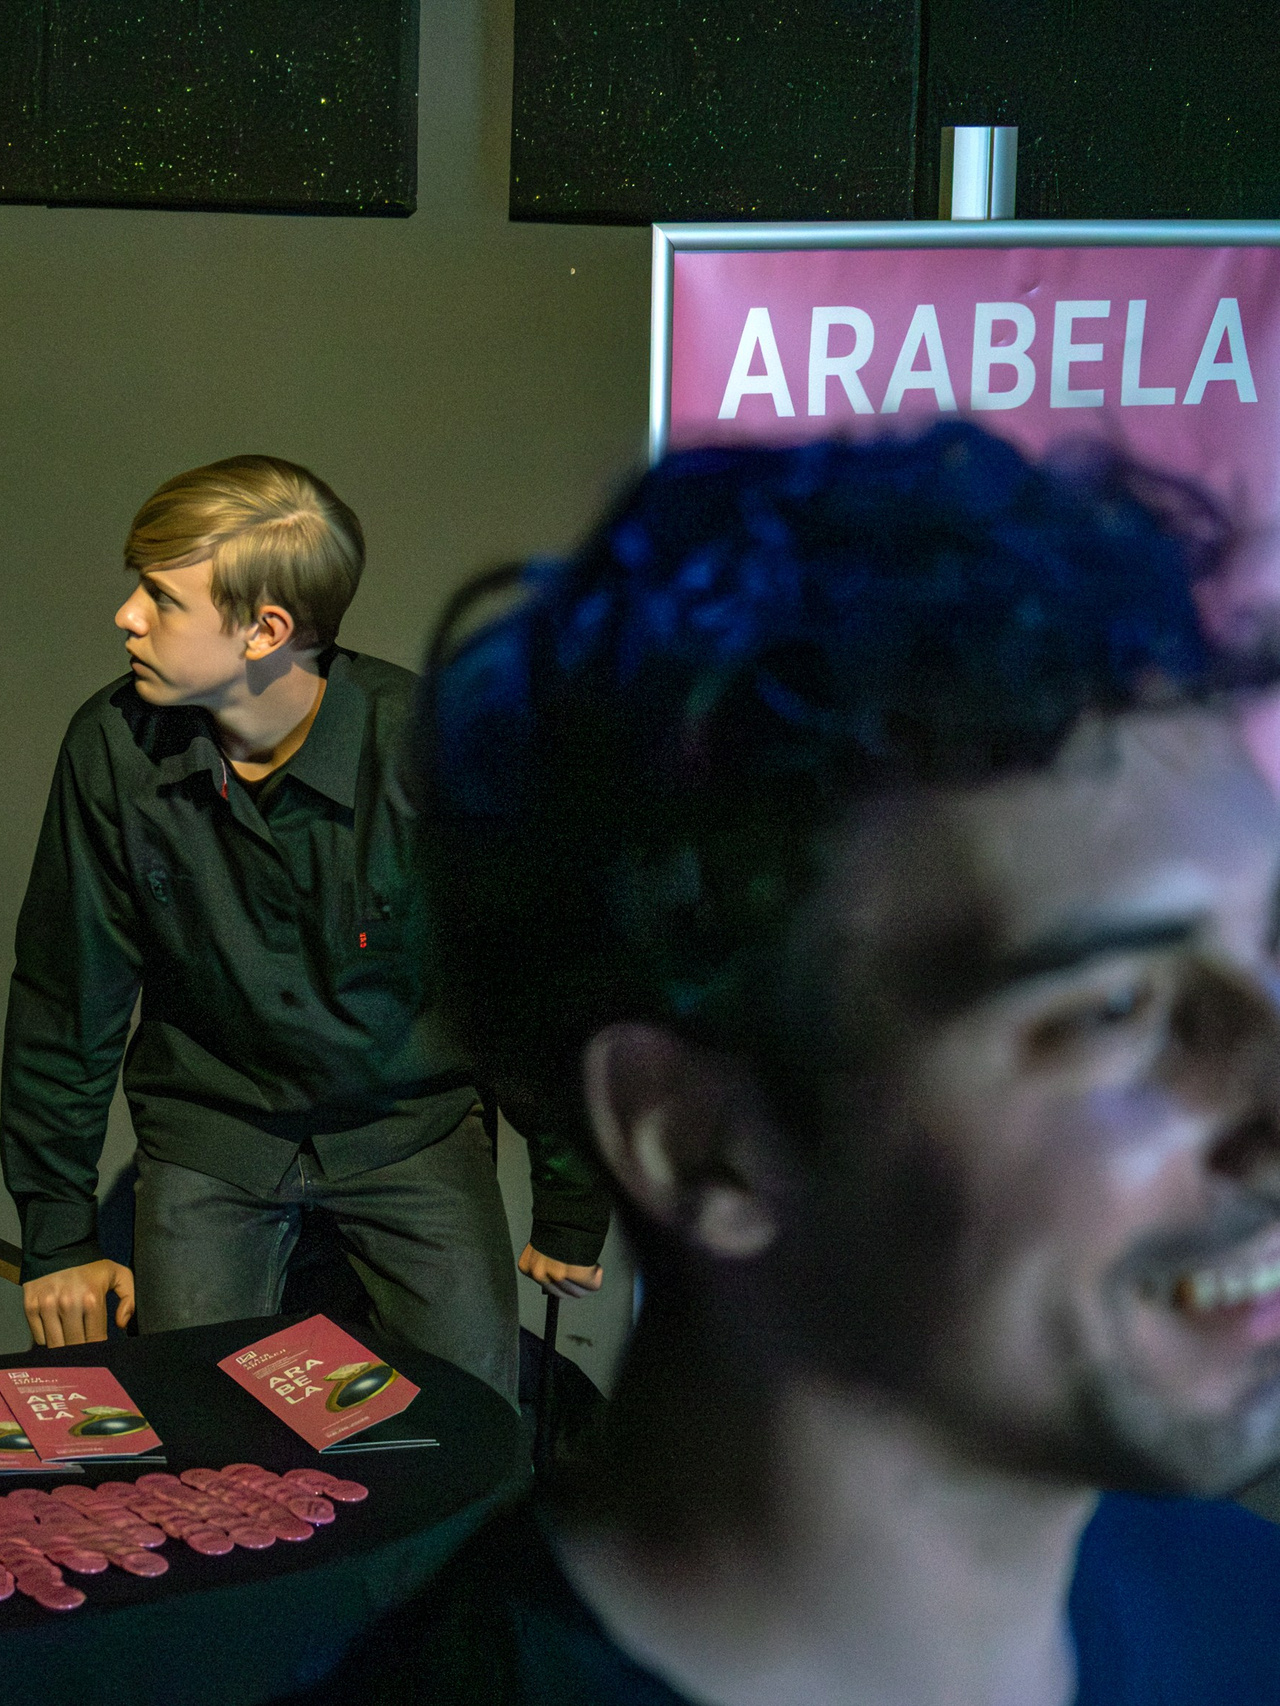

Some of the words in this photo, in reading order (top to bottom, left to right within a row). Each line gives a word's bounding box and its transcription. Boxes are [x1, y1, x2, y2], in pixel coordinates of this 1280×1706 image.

[717, 297, 1259, 420] ARABELA
[269, 1359, 324, 1389] ARA
[275, 1374, 312, 1396] BE
[26, 1392, 88, 1405] ARA
[284, 1386, 324, 1405] LA
[30, 1402, 68, 1413] BE
[35, 1410, 75, 1421] LA
